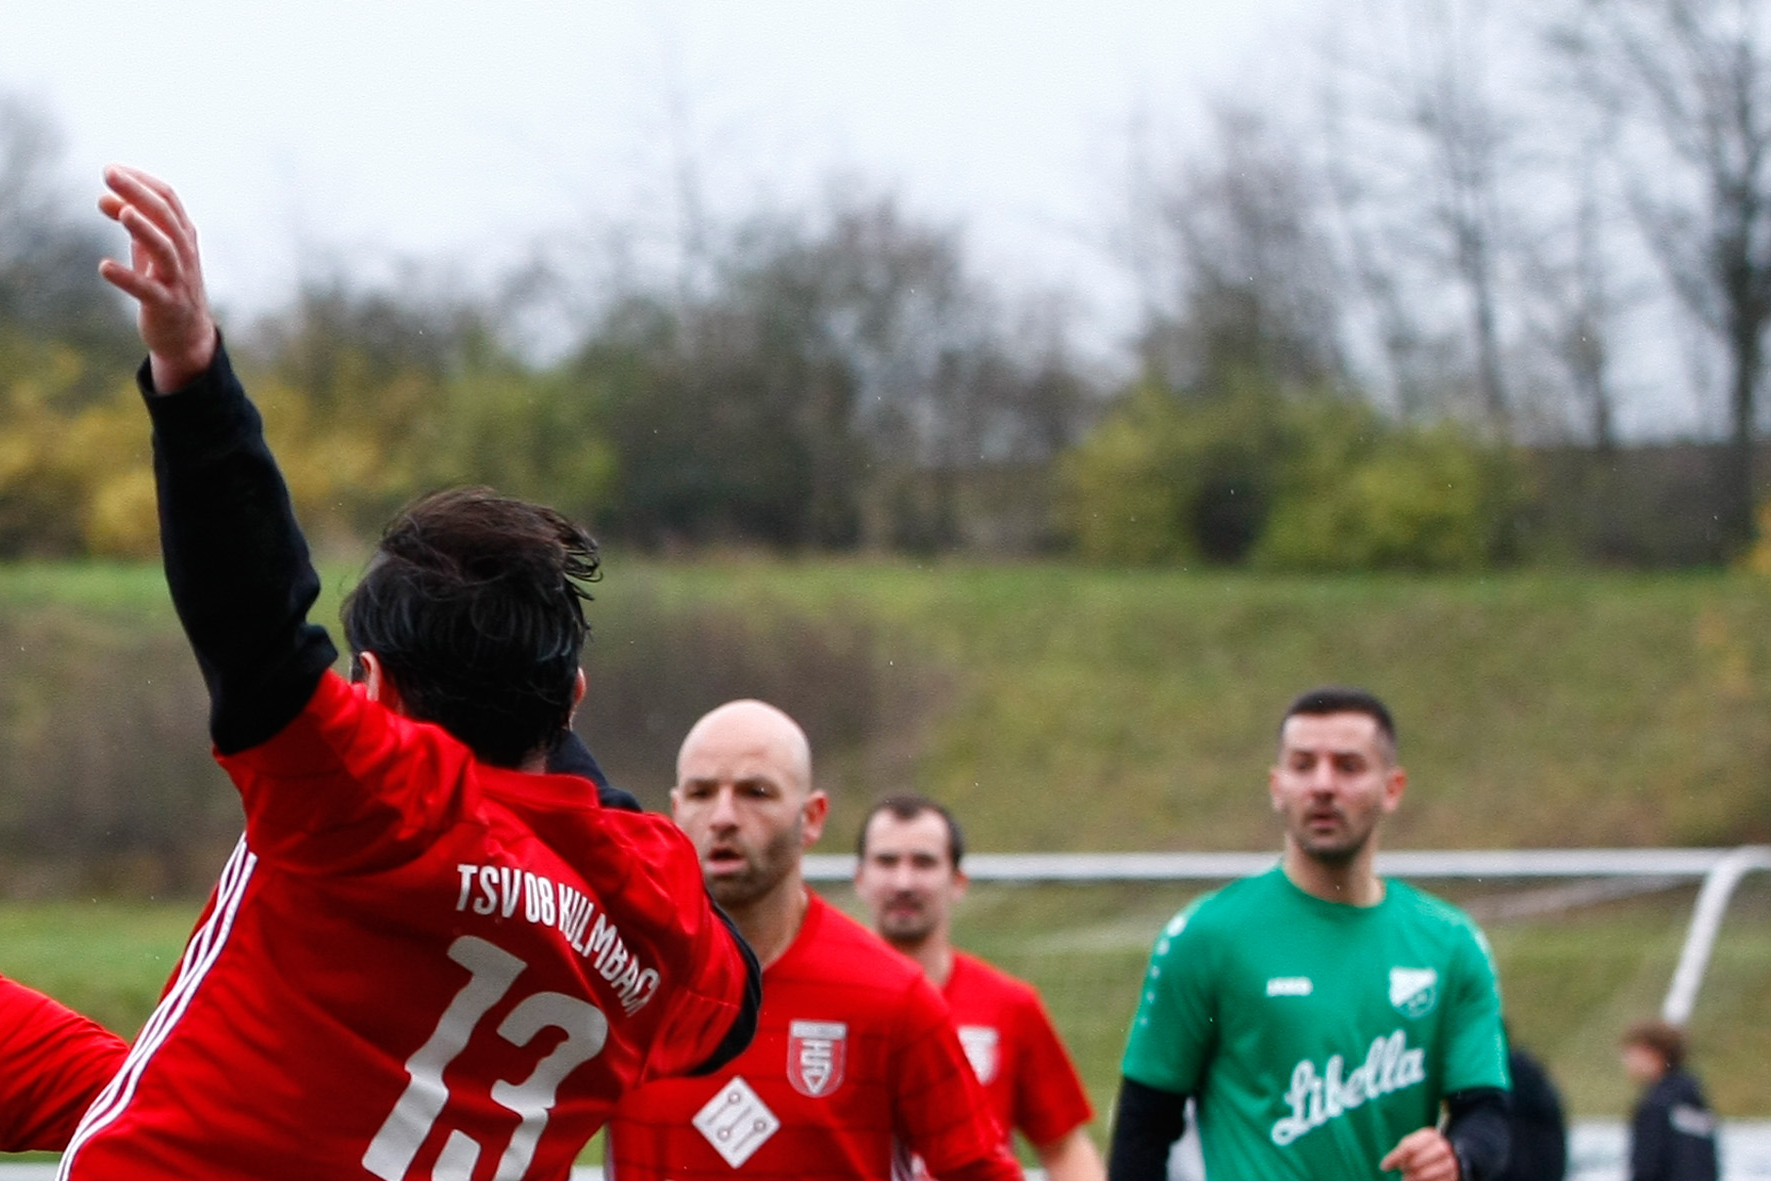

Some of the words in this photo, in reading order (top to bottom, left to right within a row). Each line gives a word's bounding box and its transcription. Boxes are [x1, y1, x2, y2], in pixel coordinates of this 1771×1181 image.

[455, 863, 521, 918] TSV
[523, 871, 556, 926] 08
[1271, 1028, 1425, 1146] Libella
